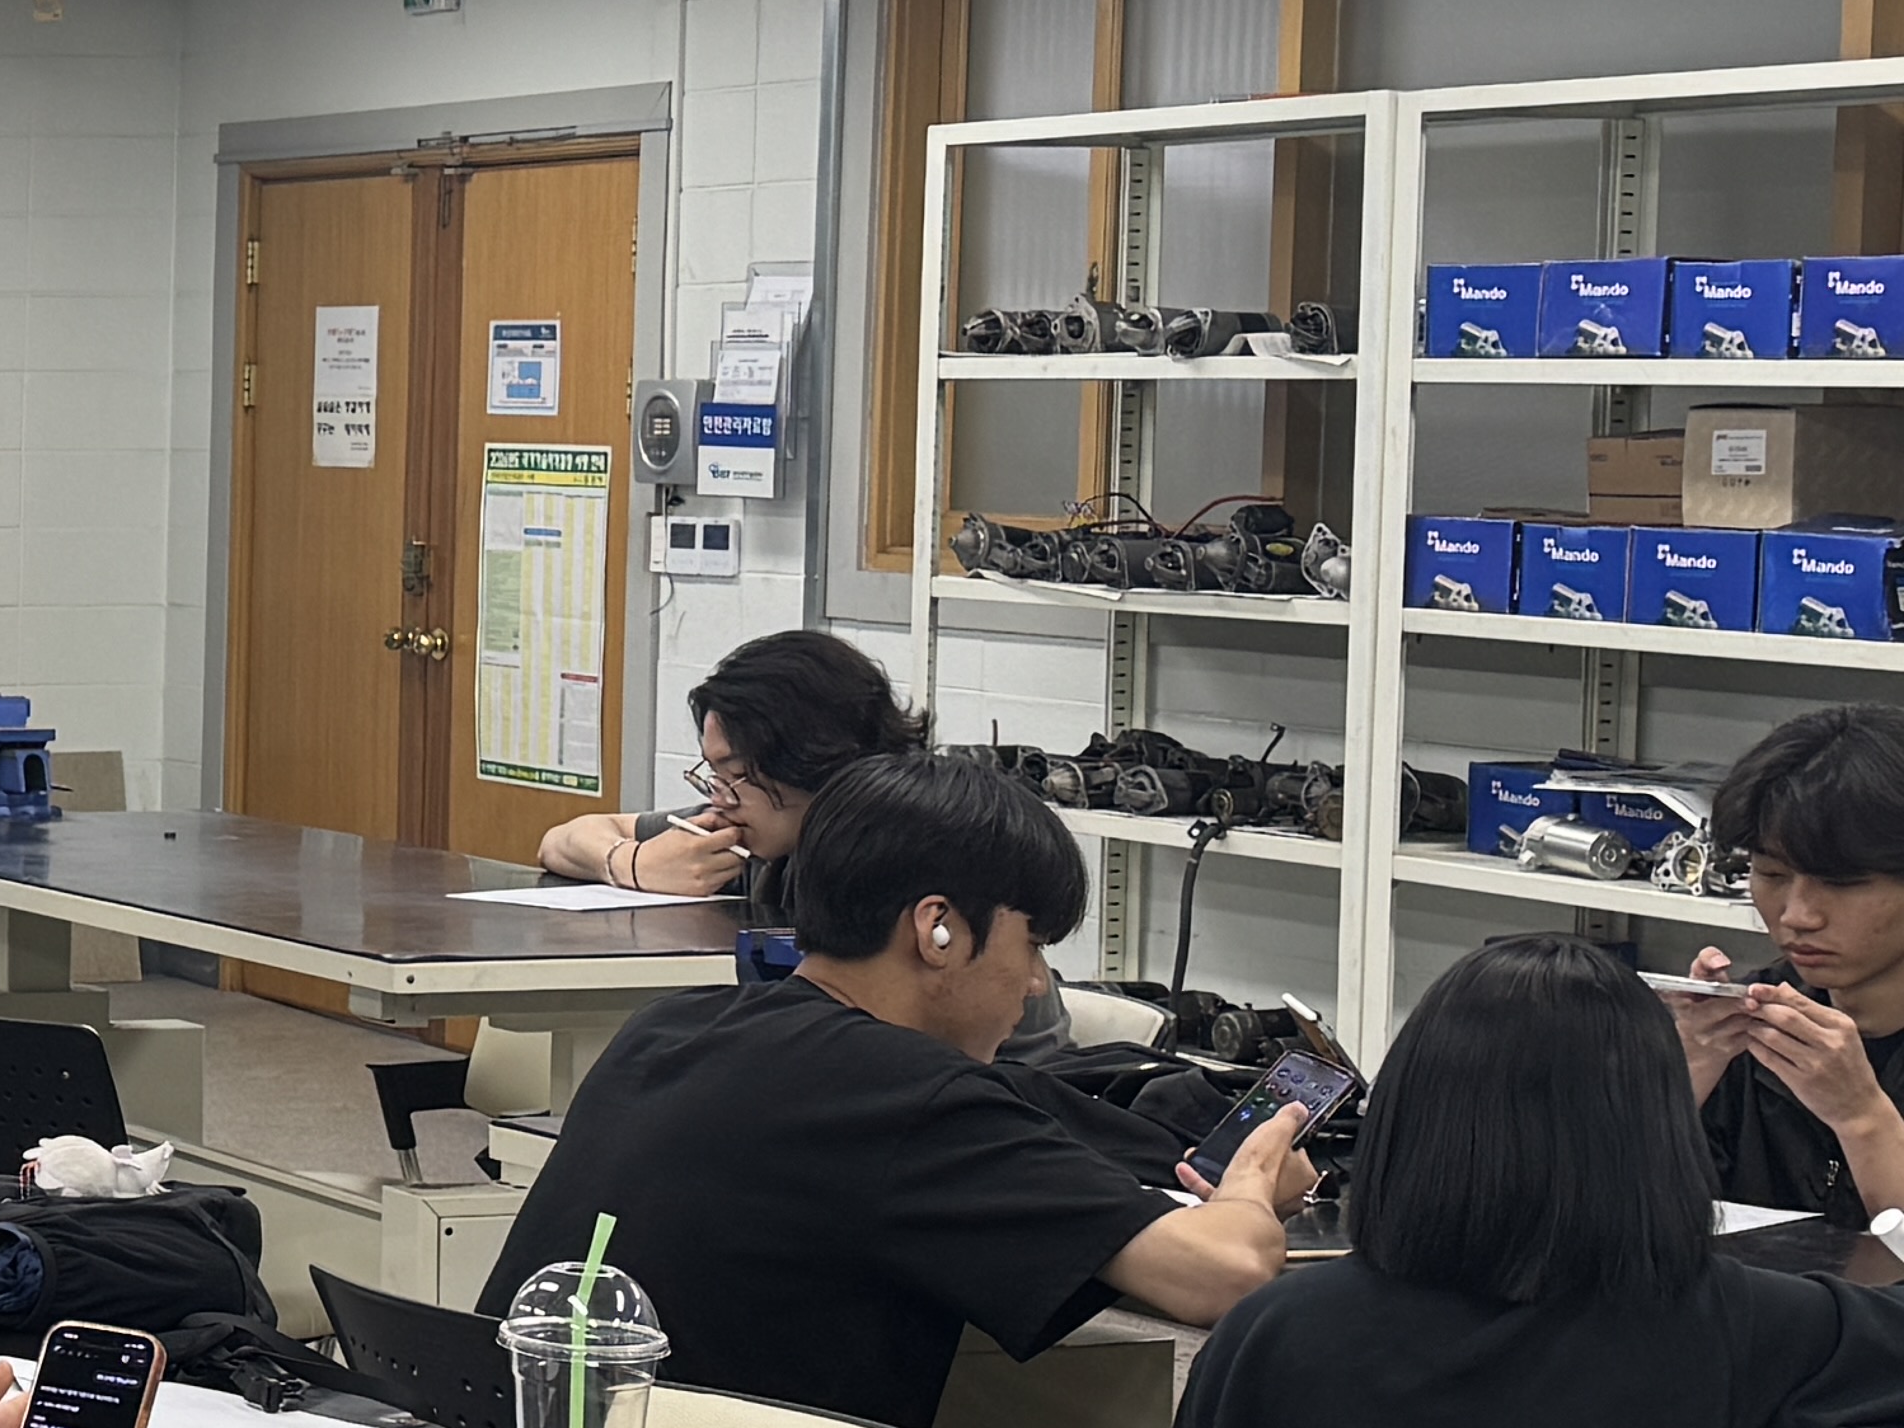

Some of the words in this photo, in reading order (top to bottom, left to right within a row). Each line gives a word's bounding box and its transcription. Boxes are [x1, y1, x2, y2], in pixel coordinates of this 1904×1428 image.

[1461, 285, 1507, 300] Mando
[1579, 282, 1629, 297] Mando
[1703, 284, 1752, 299] Mando
[1835, 279, 1885, 295] Mando
[1434, 541, 1480, 554] Mando
[1551, 548, 1600, 562] Mando
[1665, 554, 1718, 569] Mando
[1802, 559, 1855, 575] Mando
[1498, 790, 1541, 808] Mando
[1614, 802, 1664, 821] Mando
